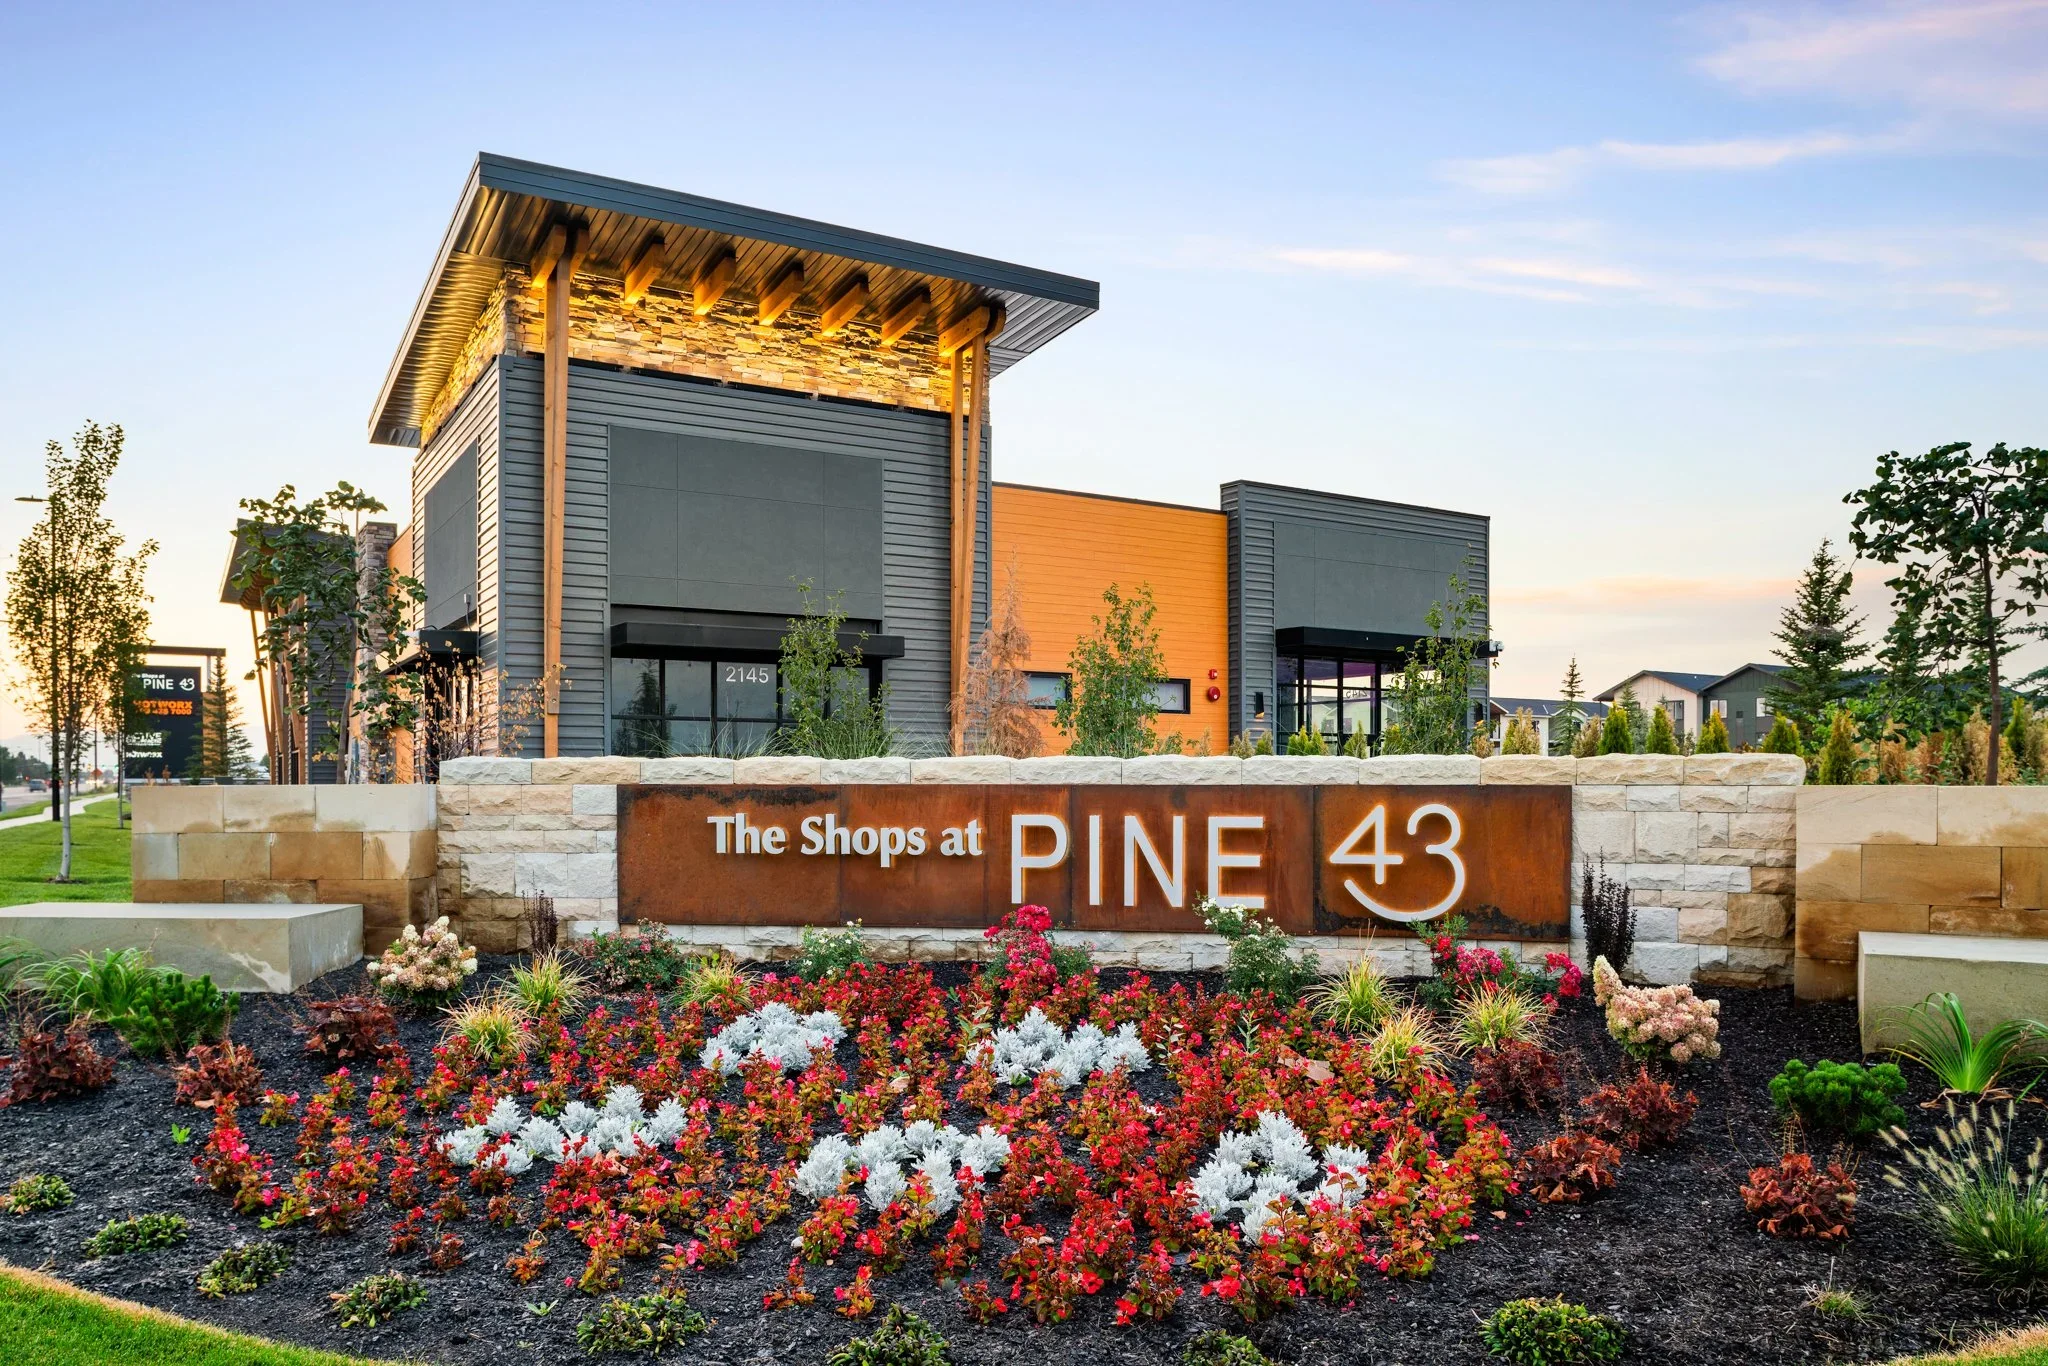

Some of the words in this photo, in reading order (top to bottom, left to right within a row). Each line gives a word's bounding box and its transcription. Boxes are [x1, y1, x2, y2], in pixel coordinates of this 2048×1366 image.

[725, 666, 769, 684] 2145
[143, 678, 174, 690] PINE
[179, 678, 195, 691] 43
[707, 812, 786, 855] The
[801, 812, 927, 868] Shops
[940, 819, 983, 856] at
[1011, 814, 1266, 909] PINE
[1329, 803, 1465, 922] 43
